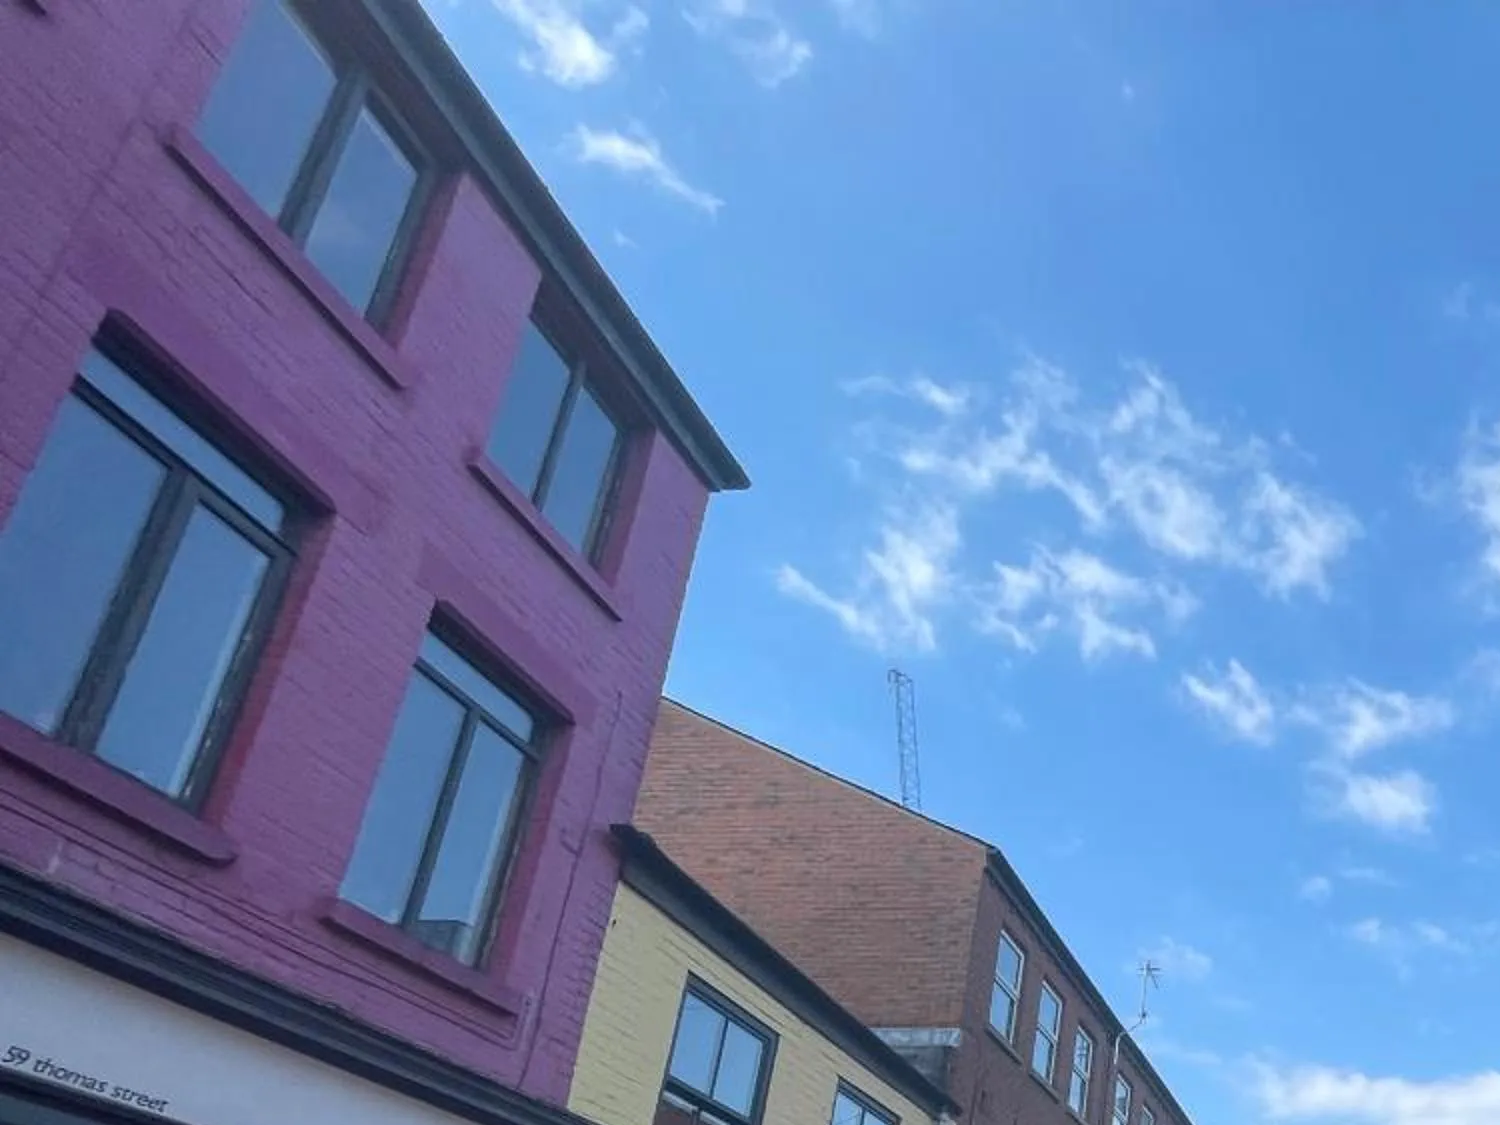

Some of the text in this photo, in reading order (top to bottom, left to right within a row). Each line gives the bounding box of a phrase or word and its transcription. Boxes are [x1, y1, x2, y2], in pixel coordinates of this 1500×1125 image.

[2, 1045, 170, 1112] 59 thomas street
